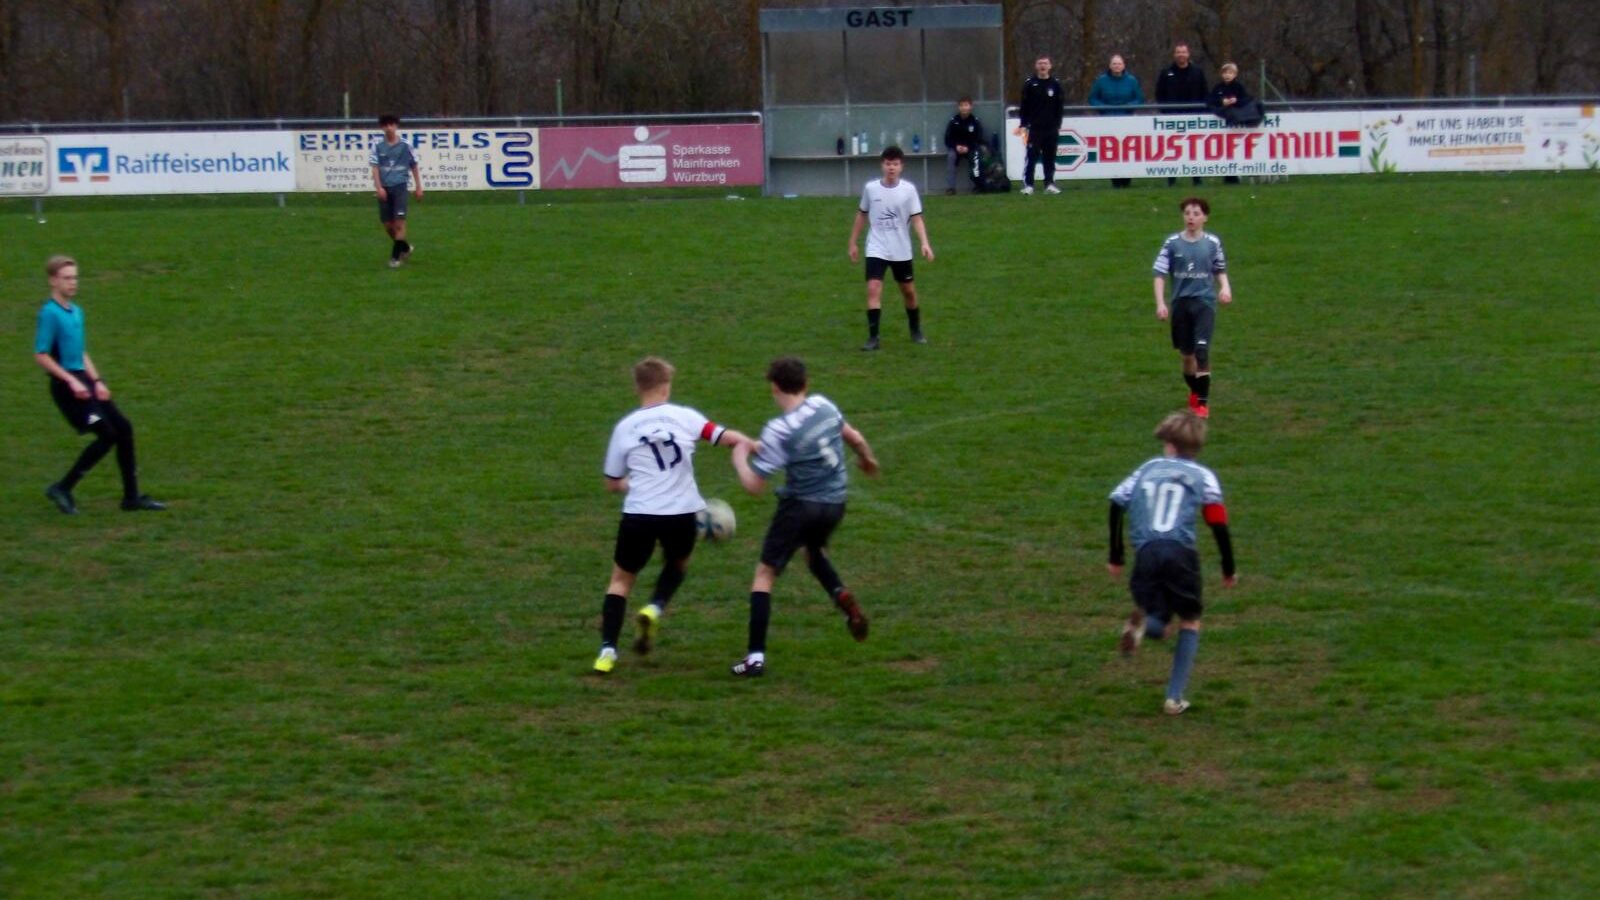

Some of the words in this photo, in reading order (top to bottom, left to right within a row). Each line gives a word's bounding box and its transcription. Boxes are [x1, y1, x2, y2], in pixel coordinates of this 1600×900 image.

[846, 10, 912, 28] GAST
[1153, 115, 1281, 132] hagebaukt
[1416, 118, 1436, 131] MIT
[1440, 117, 1462, 130] UNS
[1467, 116, 1504, 130] HABEN
[1509, 115, 1525, 127] SIE
[1099, 133, 1264, 163] BAUSTOFF
[1269, 131, 1337, 159] MILL
[1409, 134, 1446, 147] IMMER
[1450, 131, 1523, 147] HEIMVORTEIL
[439, 152, 492, 161] Haus
[673, 144, 732, 156] Sparkasse
[116, 152, 289, 174] Raiffeisenbank
[324, 166, 370, 175] Heizung
[673, 158, 740, 169] Mainfranken
[1146, 162, 1287, 175] www.baustoff-mill.de
[422, 173, 468, 181] Karlburg
[673, 171, 727, 184] Würzburg
[639, 432, 683, 472] 13
[1141, 481, 1185, 532] 10
